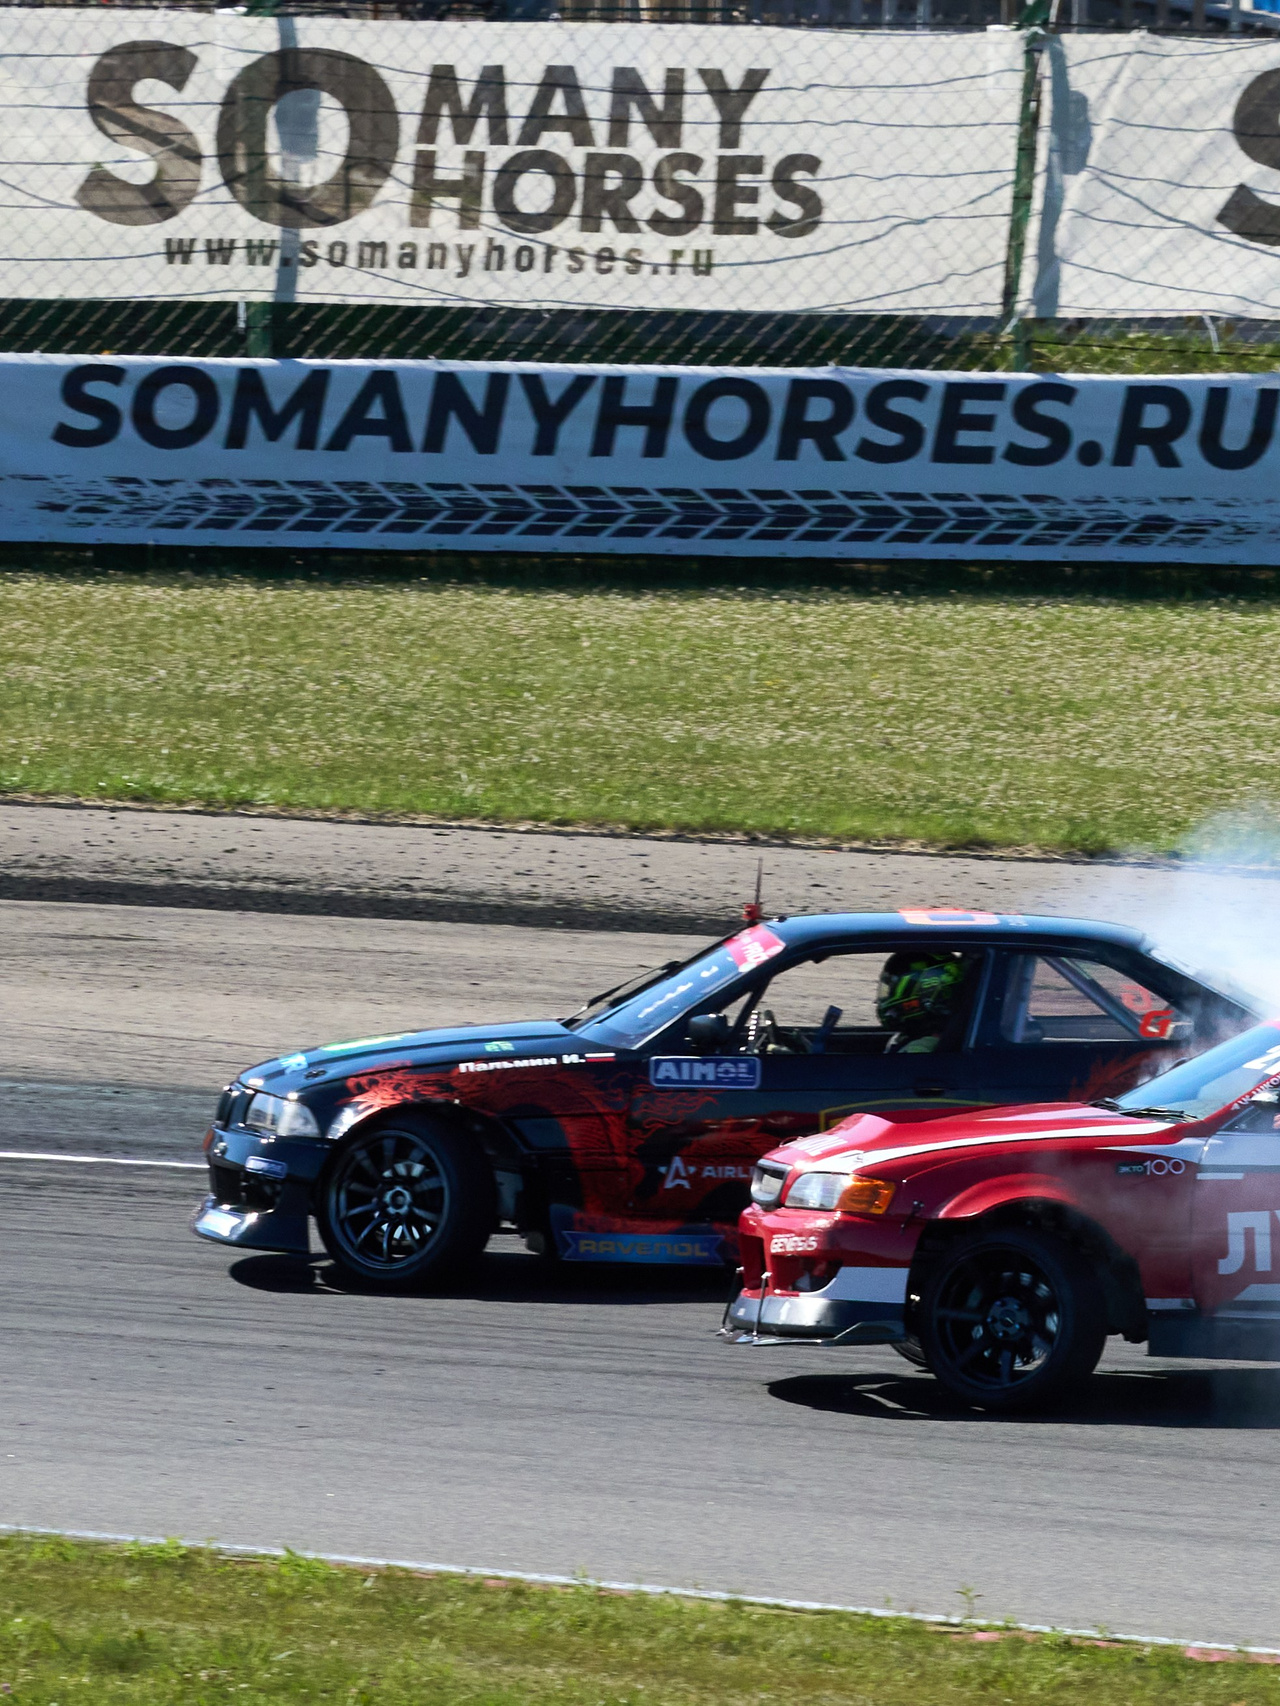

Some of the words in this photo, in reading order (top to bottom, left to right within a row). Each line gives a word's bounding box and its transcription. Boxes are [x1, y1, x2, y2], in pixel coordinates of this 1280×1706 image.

[416, 65, 771, 149] MANY
[75, 40, 400, 229] SO
[409, 148, 823, 238] HORSES
[164, 237, 713, 278] www.somanyhorses.ru
[459, 1057, 557, 1073] Пальмин
[655, 1062, 753, 1081] AIMOL
[1143, 1159, 1186, 1175] 100
[578, 1239, 710, 1257] RAVENOL
